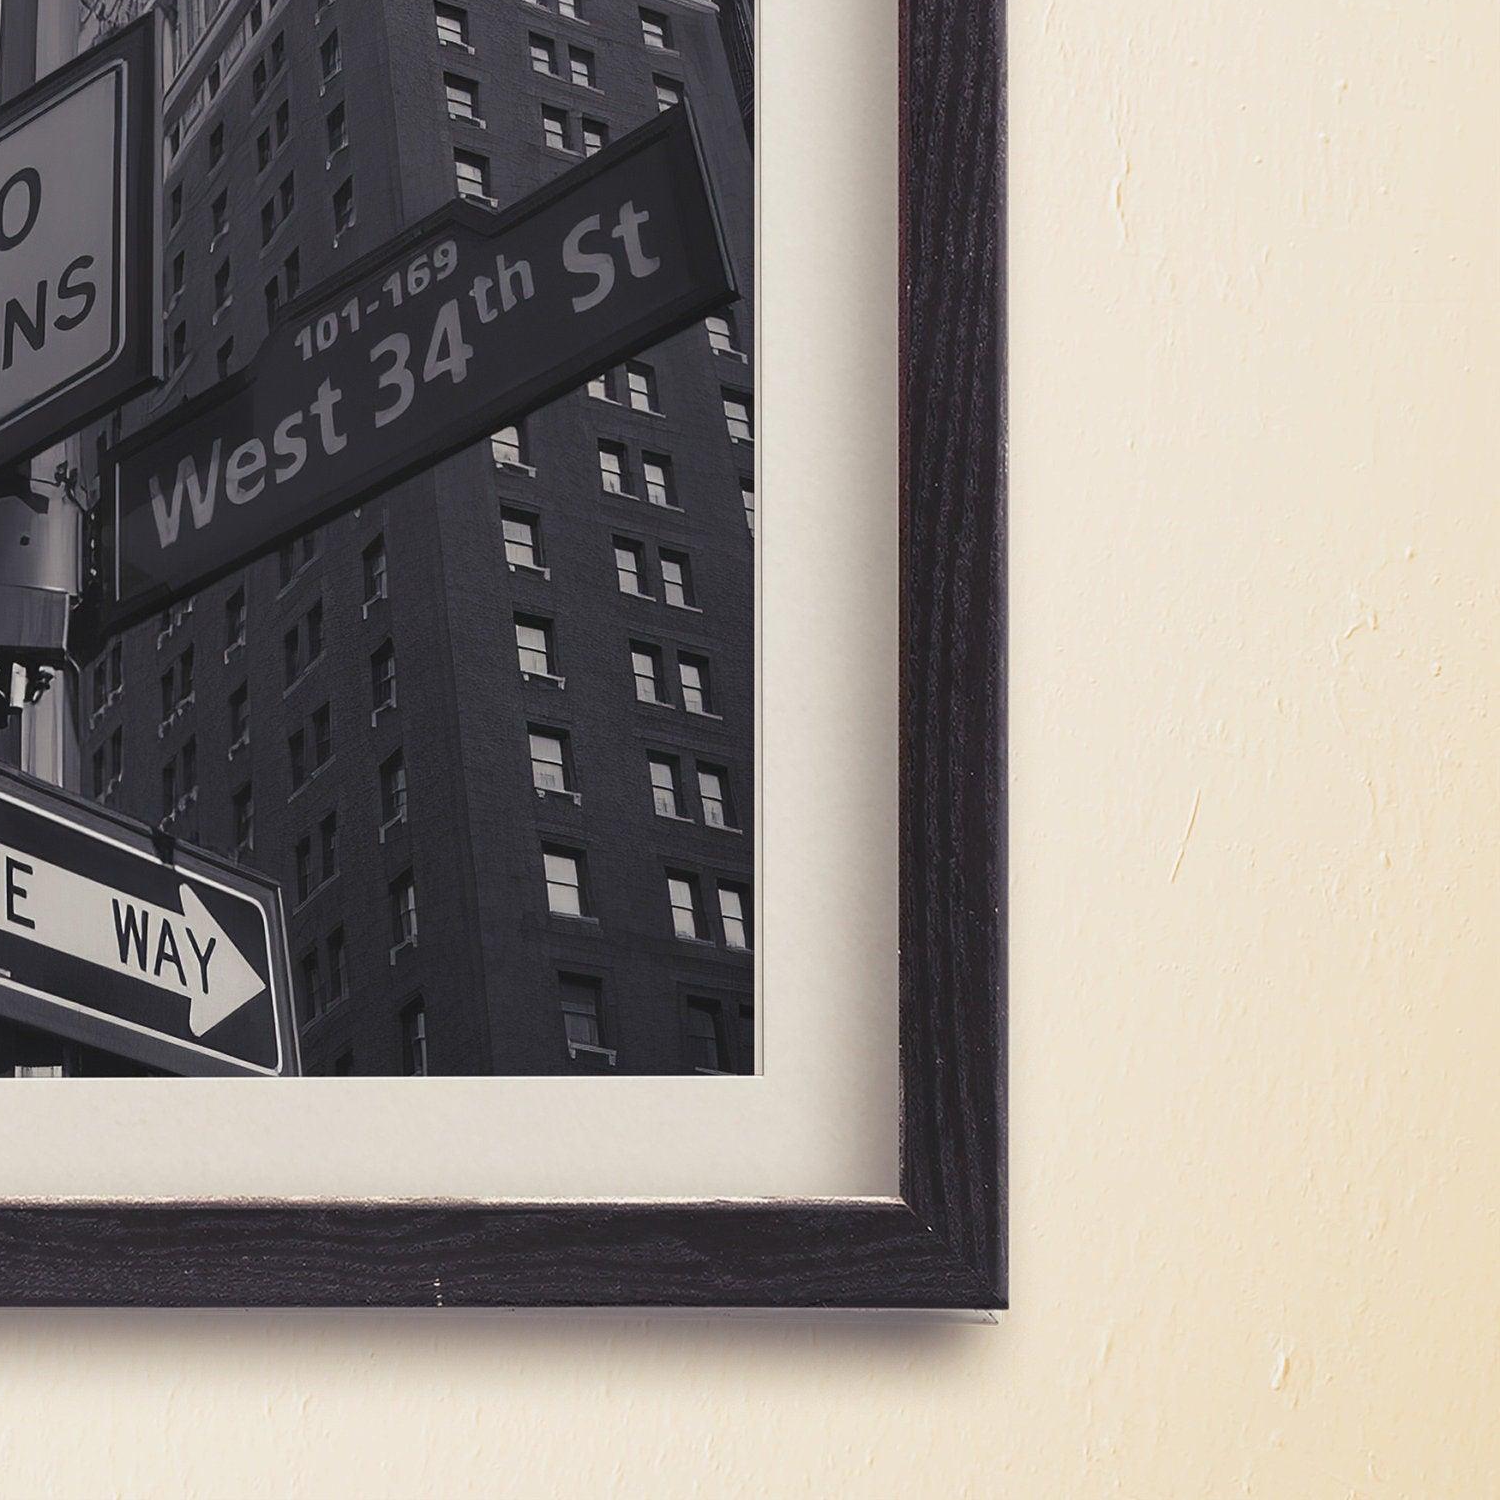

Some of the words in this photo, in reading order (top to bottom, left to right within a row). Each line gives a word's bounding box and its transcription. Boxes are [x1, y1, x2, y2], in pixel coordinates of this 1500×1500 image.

[295, 241, 458, 361] 101-169
[150, 376, 347, 549] West
[370, 254, 535, 428] 34th
[562, 201, 660, 313] St
[112, 898, 216, 995] WAY
